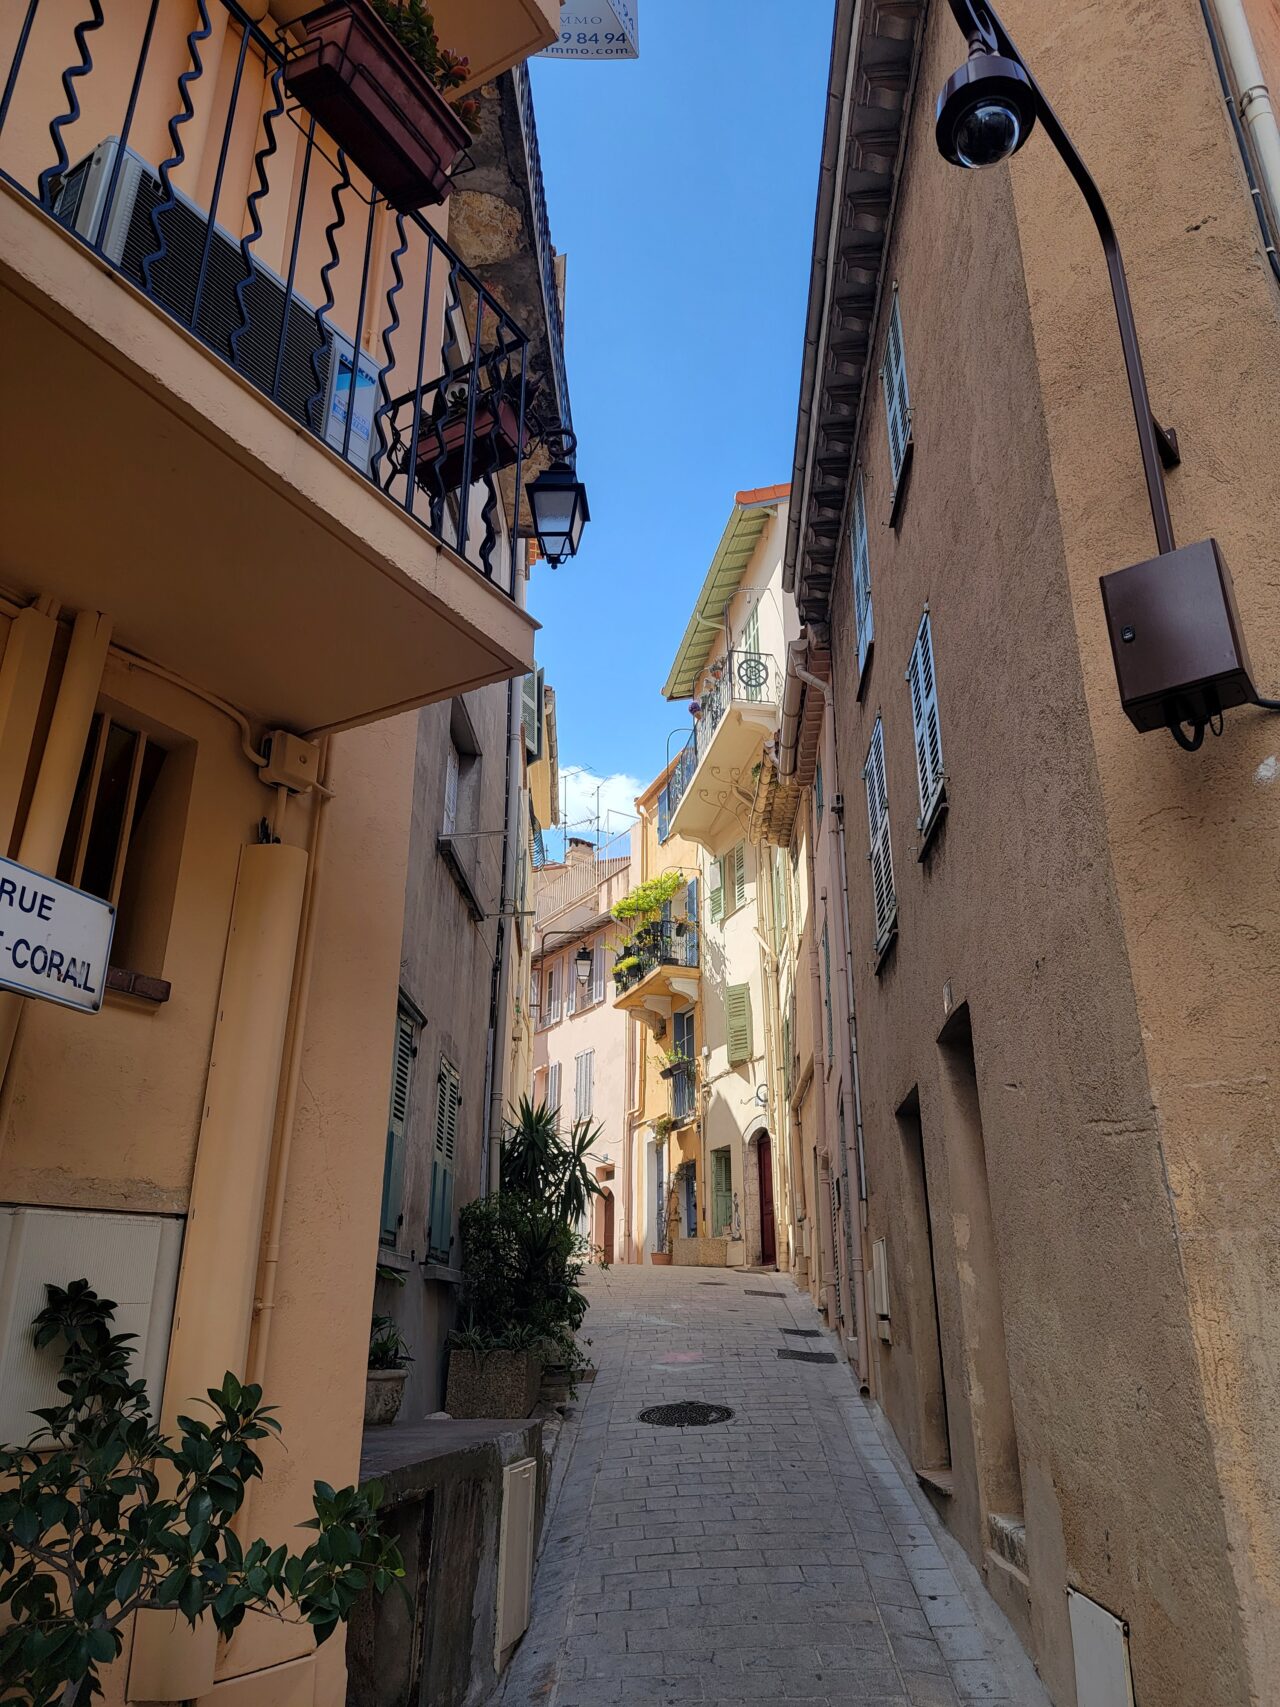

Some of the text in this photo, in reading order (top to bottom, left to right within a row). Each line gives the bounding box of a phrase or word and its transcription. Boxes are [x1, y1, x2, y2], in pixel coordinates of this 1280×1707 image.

[560, 16, 602, 24] MMO
[561, 32, 626, 44] 9 84 94
[545, 47, 628, 55] immo.com
[0, 877, 56, 921] RUE
[0, 930, 96, 994] -CORAIL
